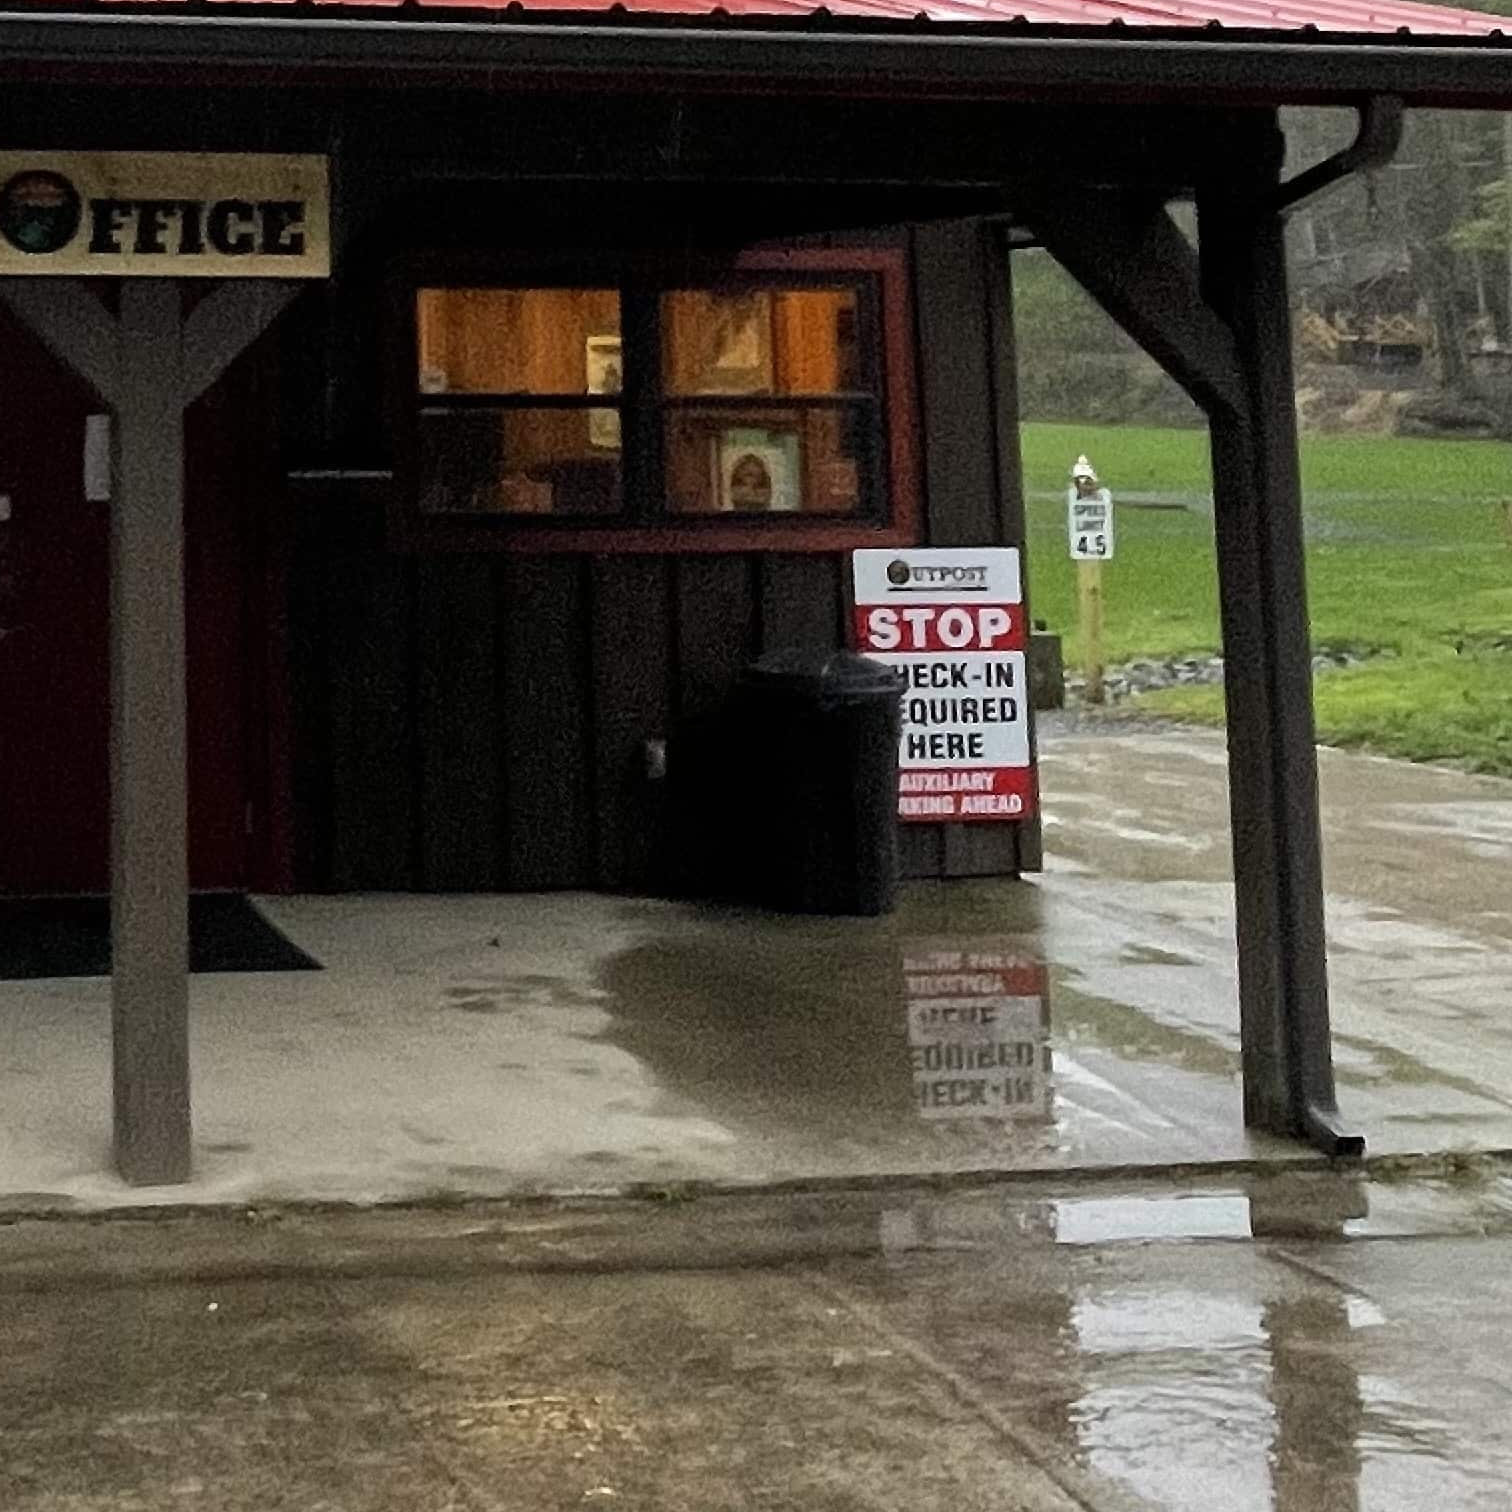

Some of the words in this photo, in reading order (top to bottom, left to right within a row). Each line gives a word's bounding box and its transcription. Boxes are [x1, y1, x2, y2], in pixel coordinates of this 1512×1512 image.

[867, 608, 1012, 649] STOP
[894, 662, 1014, 688] HECK-IN
[908, 732, 985, 759] HERE
